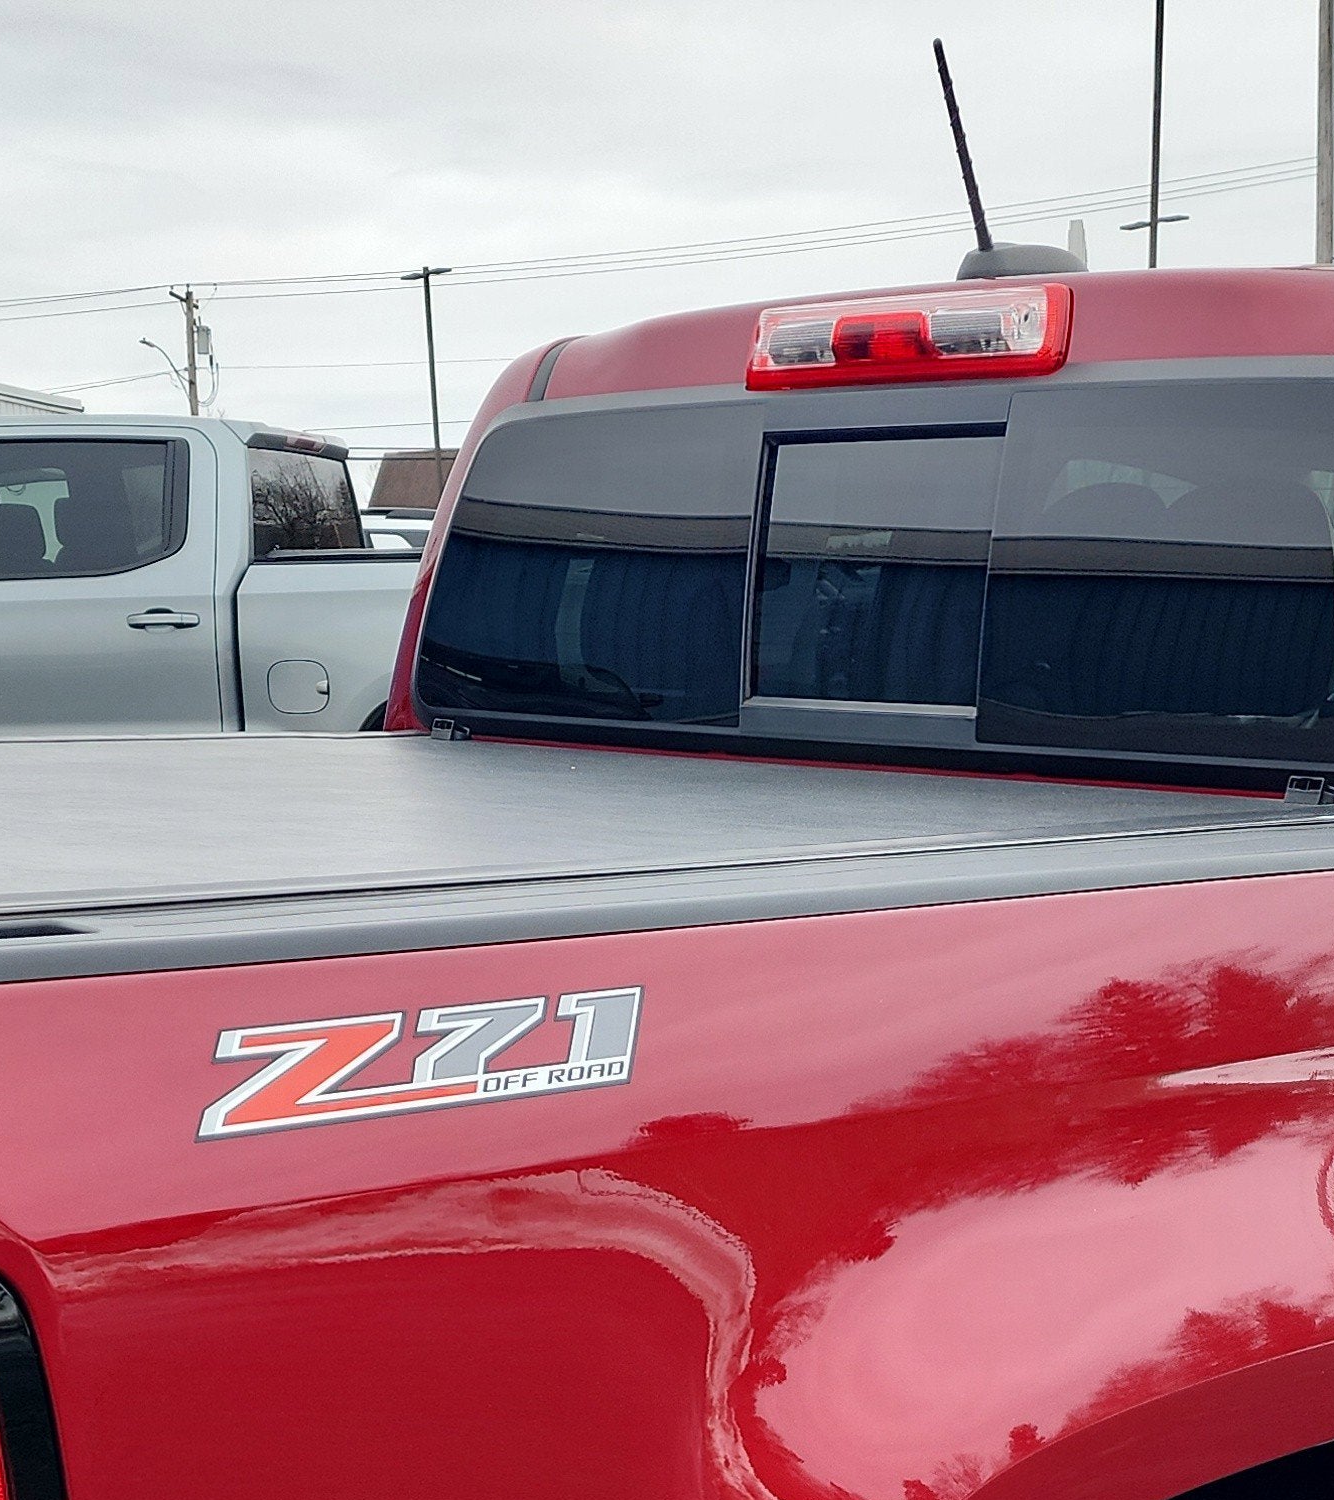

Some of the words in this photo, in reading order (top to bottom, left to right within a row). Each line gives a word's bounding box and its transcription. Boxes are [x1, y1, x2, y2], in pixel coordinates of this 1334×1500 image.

[194, 985, 643, 1142] Z71
[483, 1070, 540, 1093] OFF
[547, 1061, 624, 1085] ROAD
